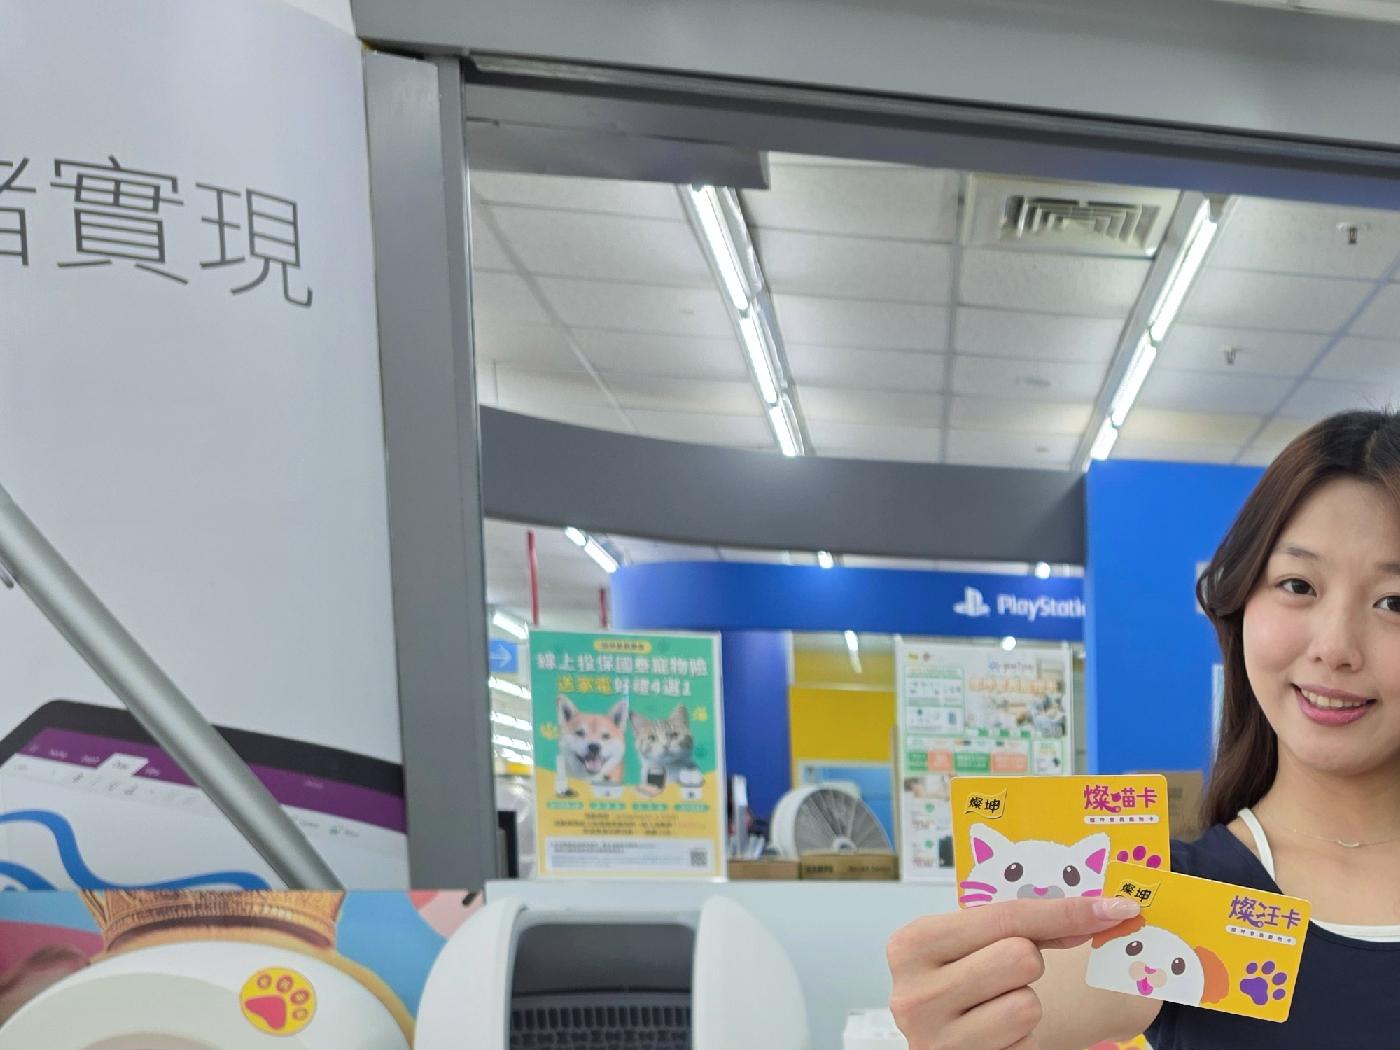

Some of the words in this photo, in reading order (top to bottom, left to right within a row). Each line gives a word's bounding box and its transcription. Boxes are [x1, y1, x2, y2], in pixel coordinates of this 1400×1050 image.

[997, 594, 1087, 621] PlayStati
[969, 796, 1001, 813] 燦坤
[1084, 784, 1158, 814] 燦喵卡
[1120, 883, 1152, 903] 燦坤
[1228, 895, 1302, 929] 燦汪卡
